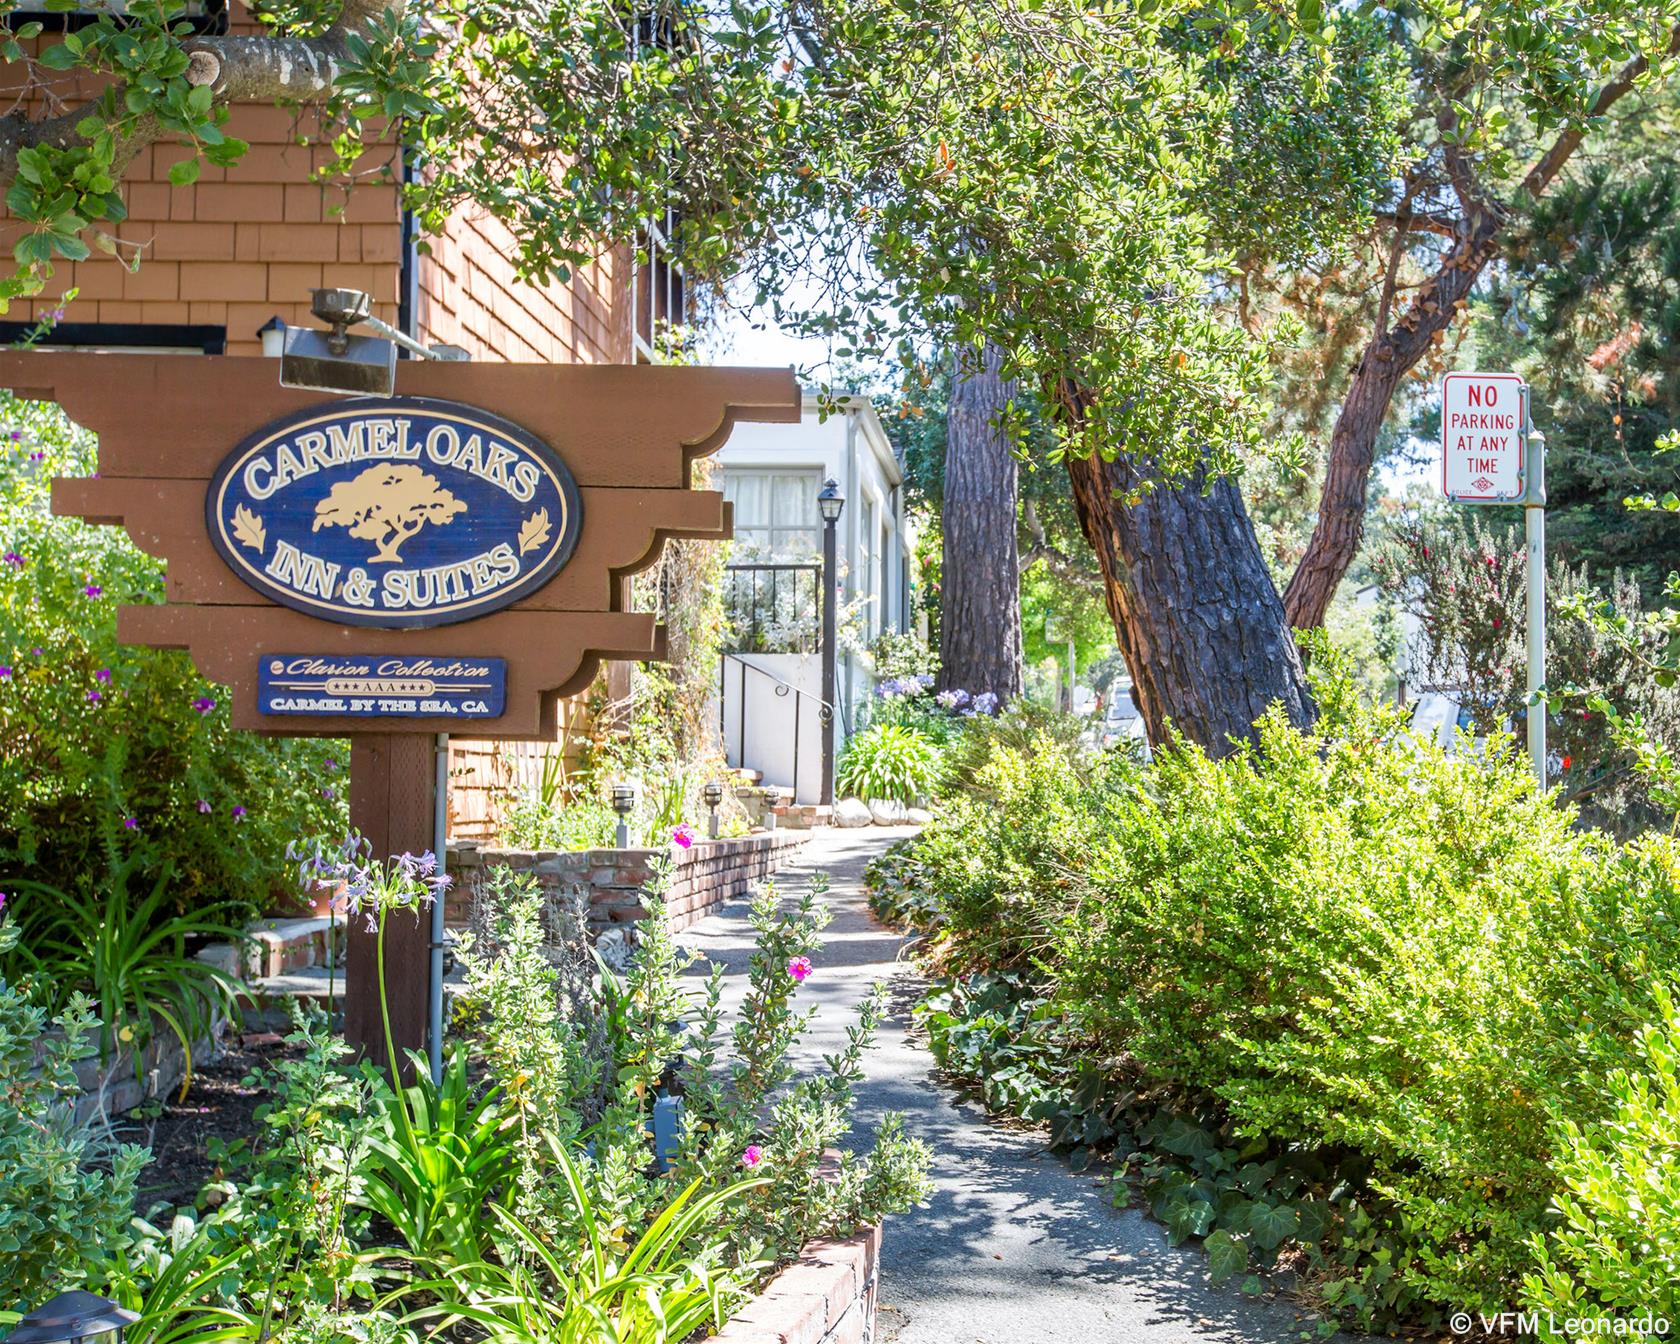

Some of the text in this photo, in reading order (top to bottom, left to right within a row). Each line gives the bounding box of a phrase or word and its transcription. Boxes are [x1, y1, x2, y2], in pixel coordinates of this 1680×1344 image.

[1469, 385, 1497, 407] NO
[1452, 413, 1514, 429] PARKING
[1457, 435, 1508, 451] AT ANY
[244, 419, 540, 502] CARMEL OAKS
[1467, 458, 1498, 474] TIME
[265, 540, 520, 608] INN & SUITES
[286, 659, 490, 677] Clarion Collection
[270, 698, 489, 713] CARMEL BY THE SEA, CA
